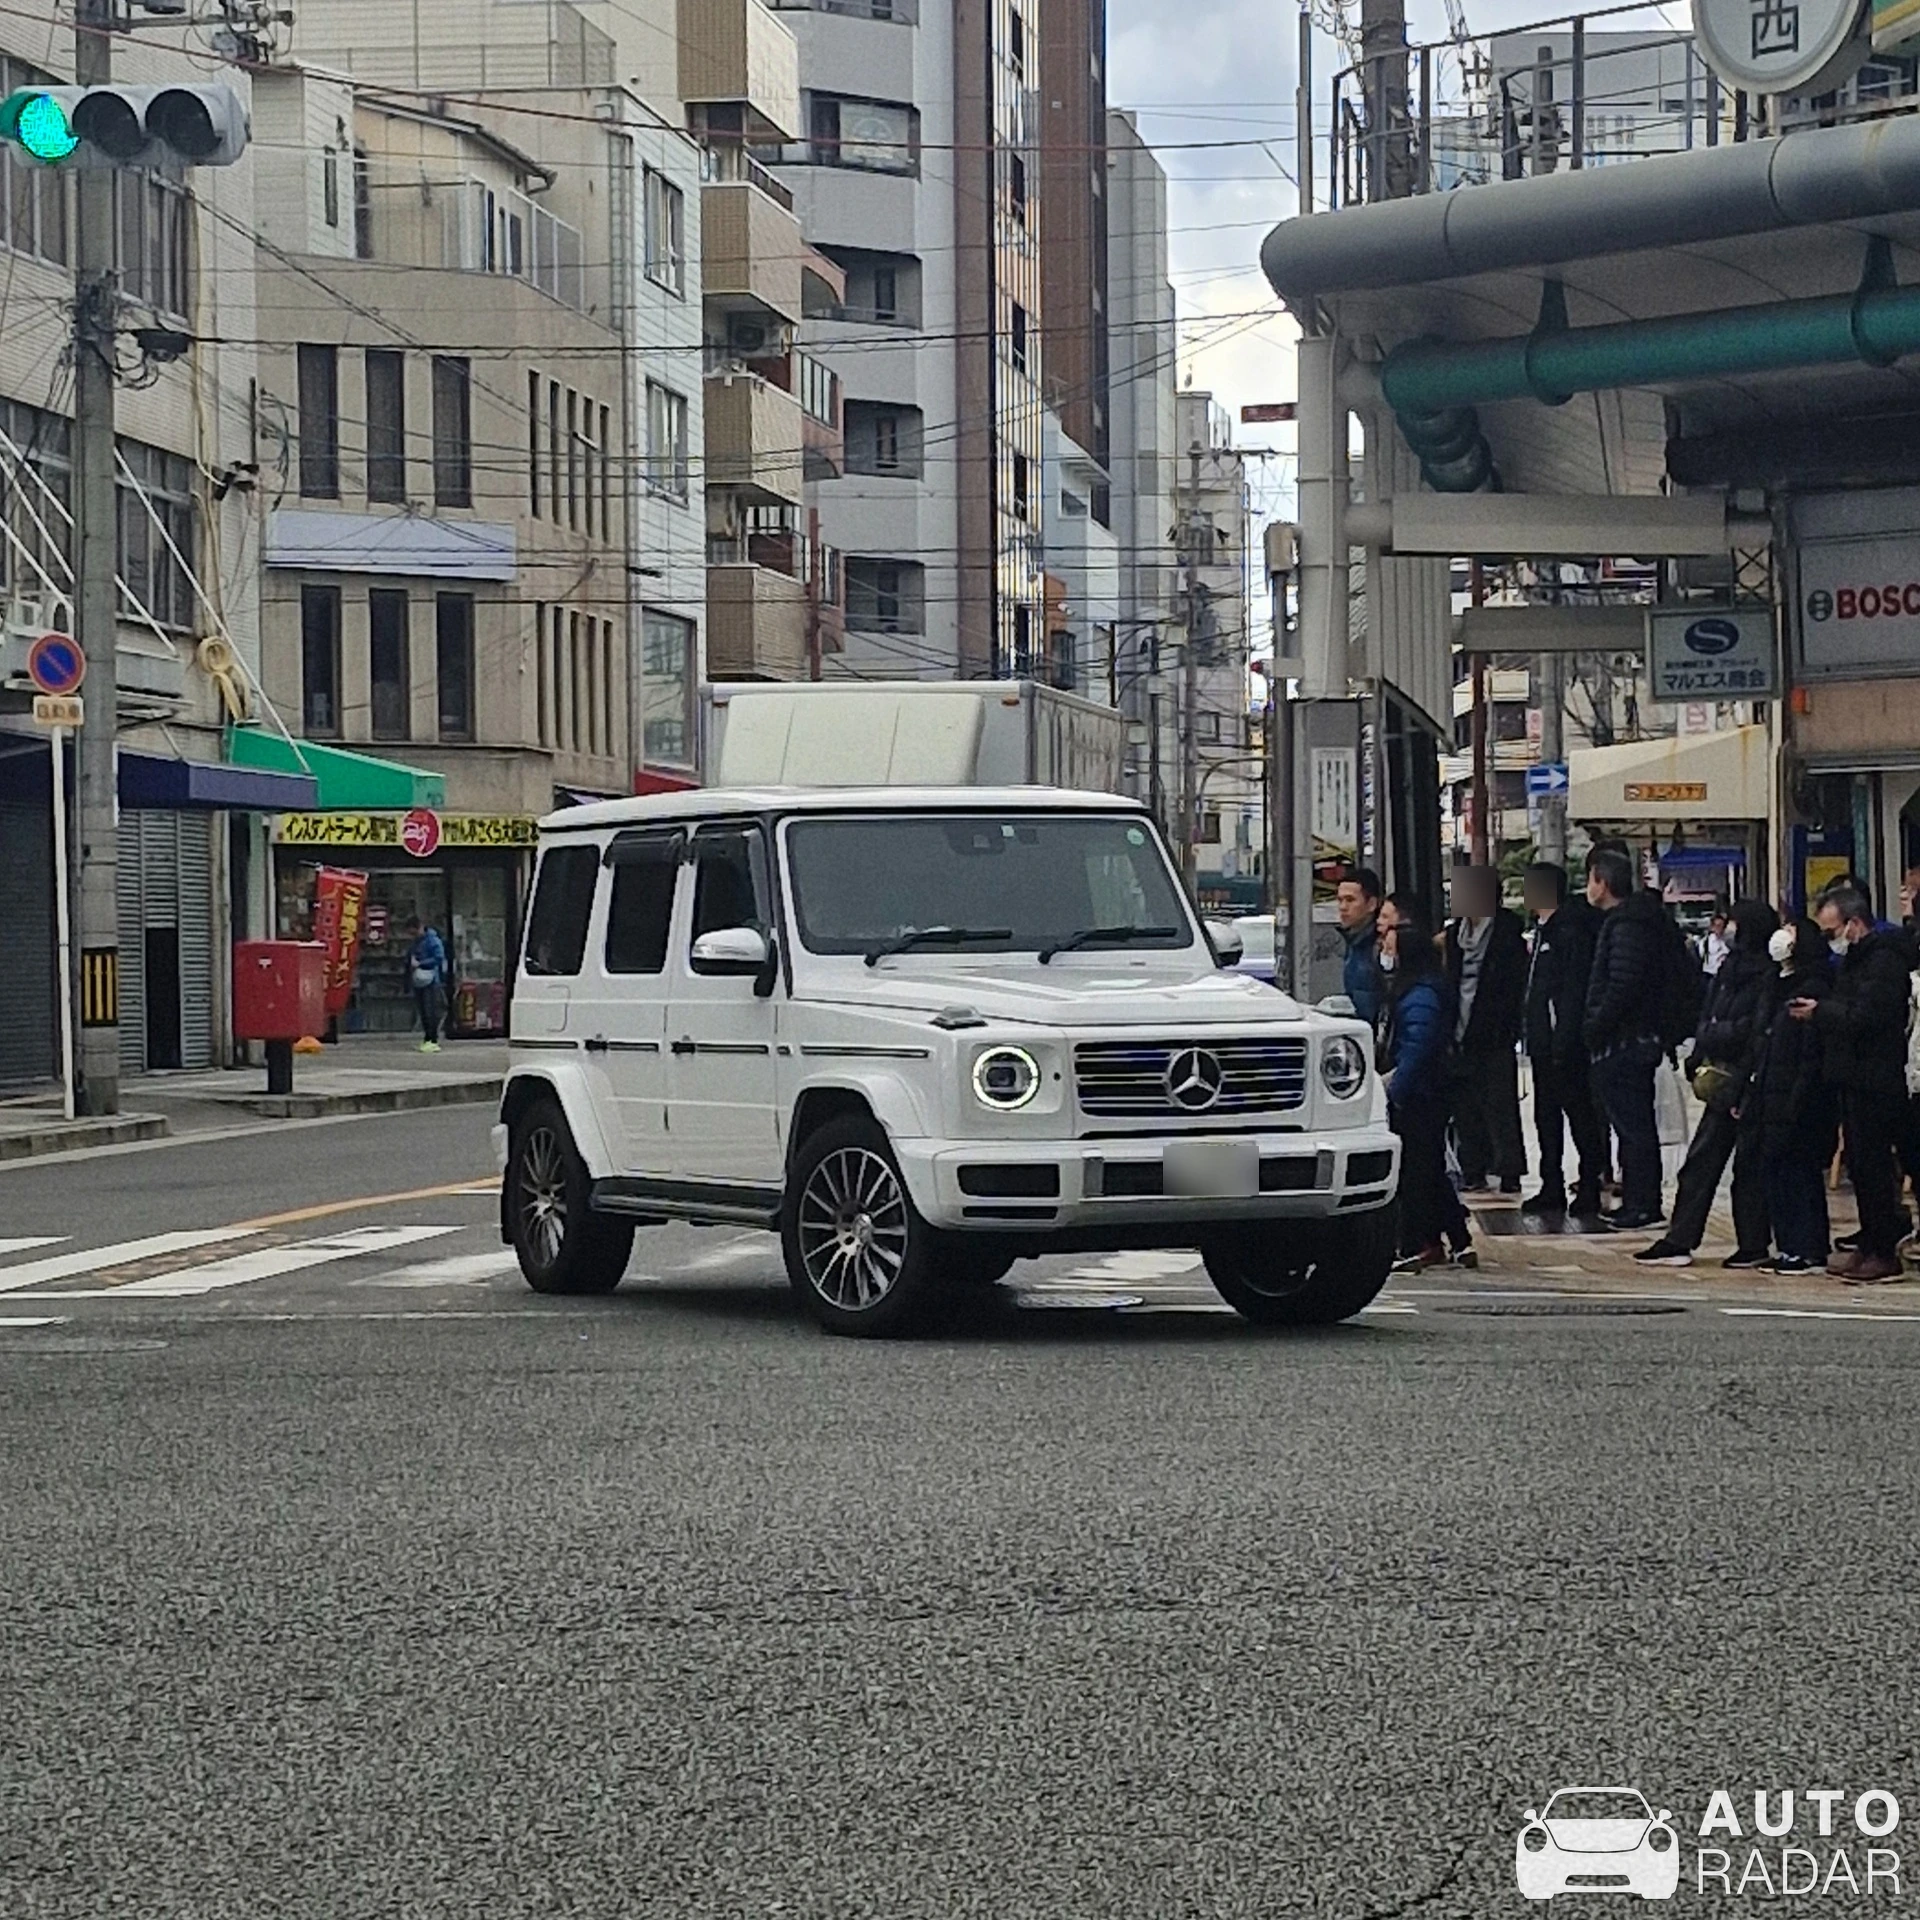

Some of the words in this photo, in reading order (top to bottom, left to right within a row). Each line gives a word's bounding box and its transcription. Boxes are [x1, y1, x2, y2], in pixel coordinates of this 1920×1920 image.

[1836, 583, 1920, 619] BOSC
[1661, 668, 1766, 690] マルエス商会
